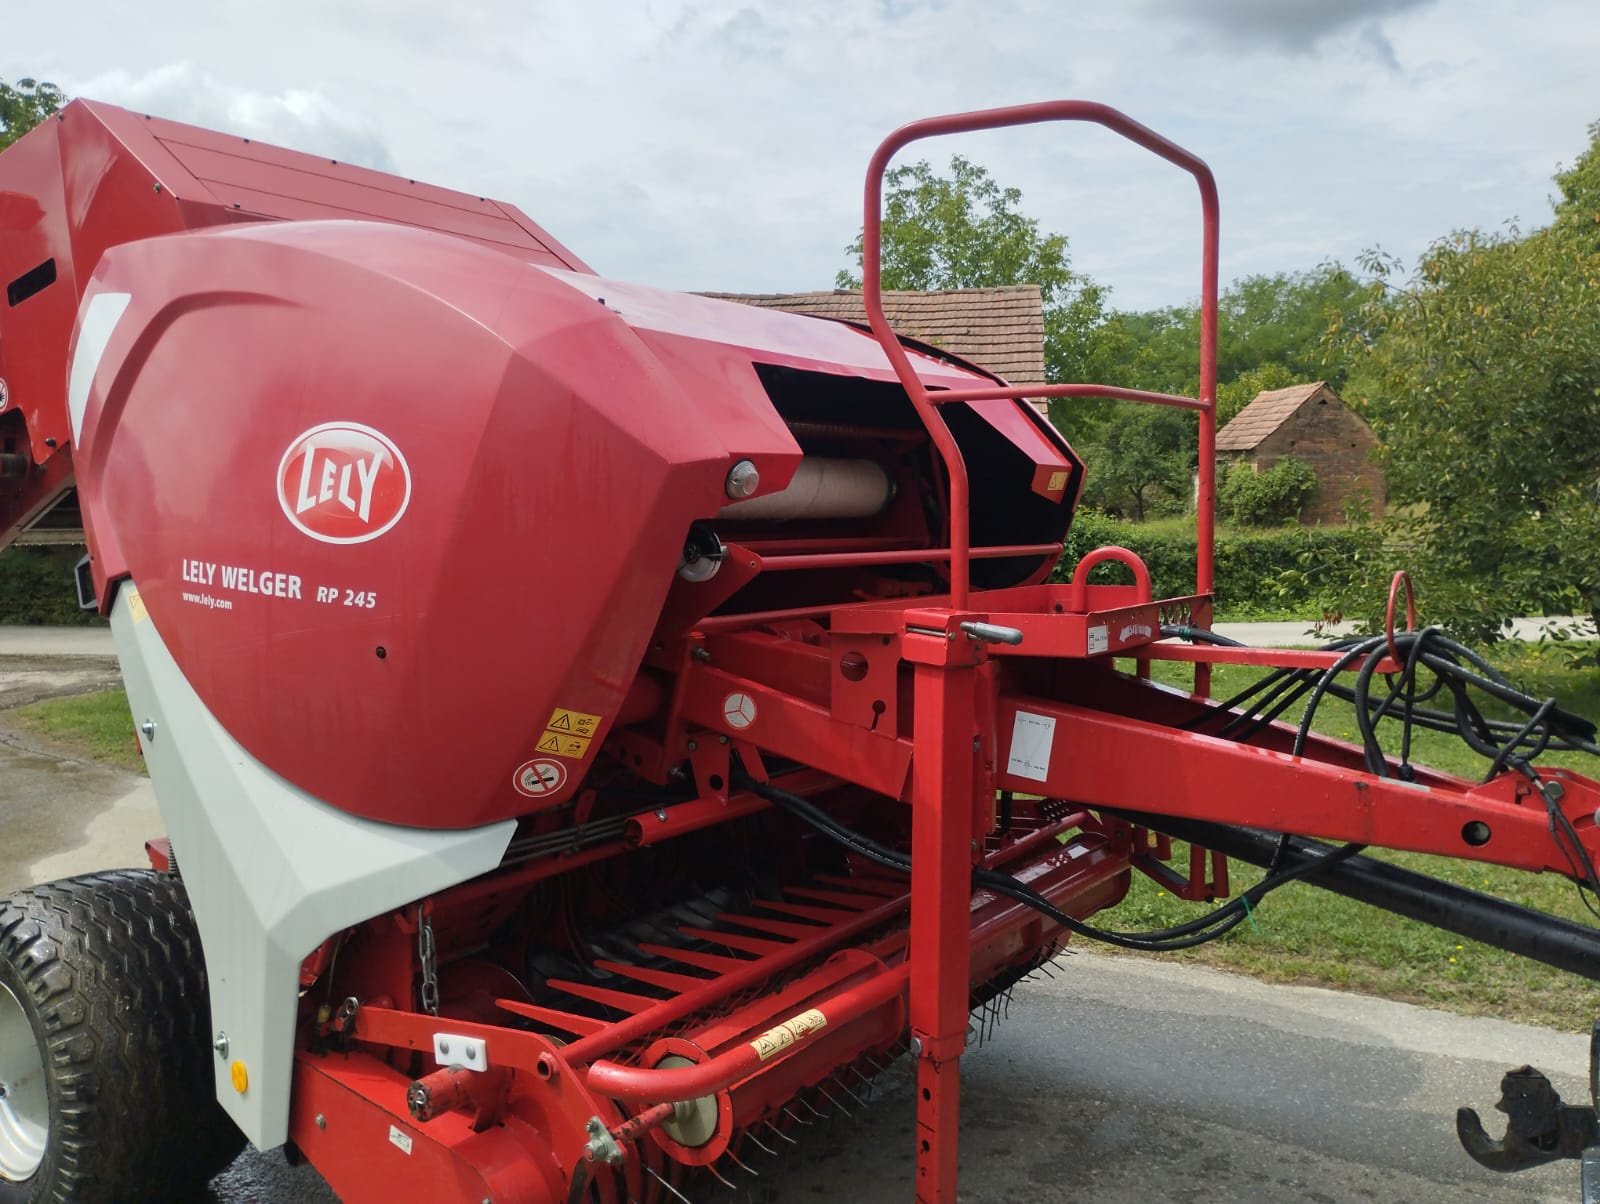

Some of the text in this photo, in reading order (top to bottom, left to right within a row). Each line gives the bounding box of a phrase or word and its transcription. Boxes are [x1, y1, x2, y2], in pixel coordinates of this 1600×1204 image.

[296, 443, 385, 524] LELY
[182, 559, 377, 609] LELY WELGER RP 245
[182, 592, 233, 610] www.lely.com
